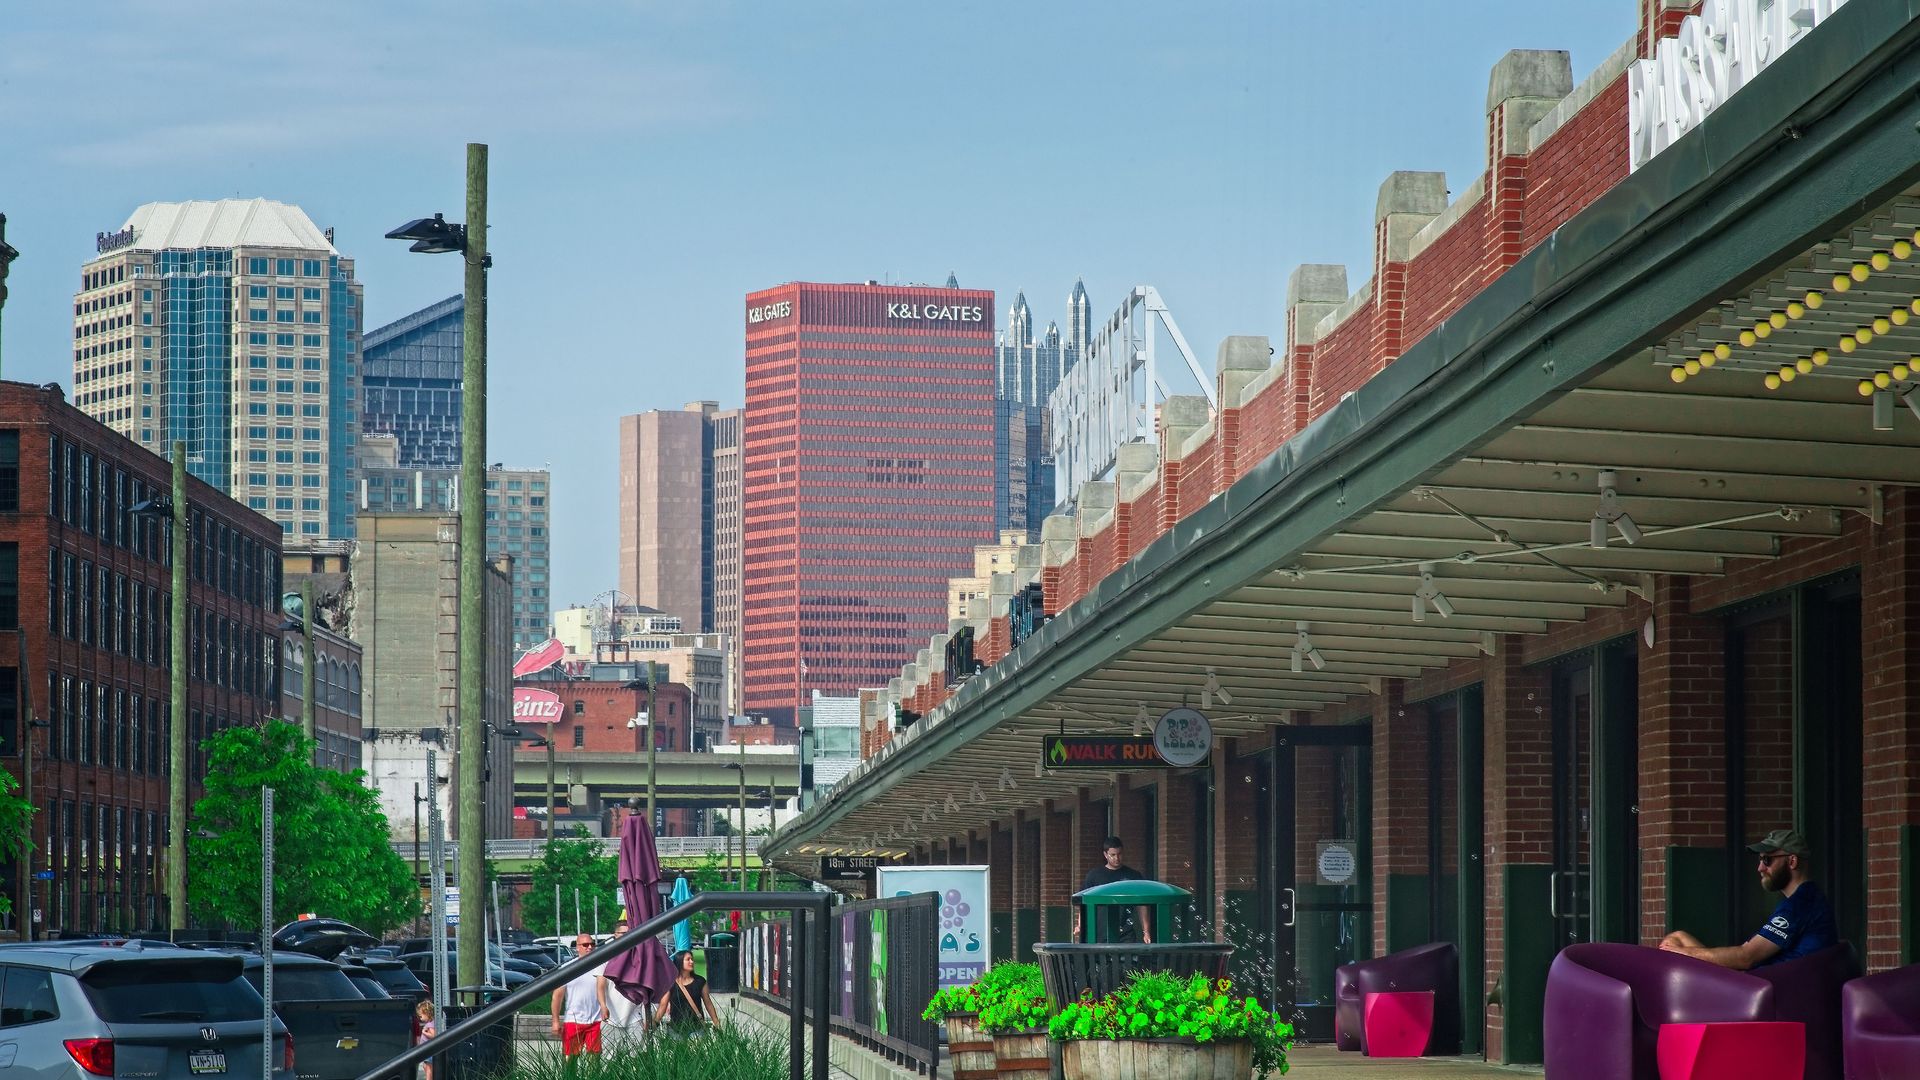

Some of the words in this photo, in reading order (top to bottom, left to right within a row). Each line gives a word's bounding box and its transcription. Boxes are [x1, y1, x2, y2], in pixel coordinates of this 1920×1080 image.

[749, 306, 764, 323] K&L
[764, 301, 791, 320] GATES
[887, 303, 921, 319] K&L
[924, 304, 982, 322] GATES
[514, 696, 558, 717] einz
[1066, 744, 1116, 760] WALK
[829, 858, 845, 868] 18TH
[849, 857, 877, 868] STREET
[939, 967, 978, 980] OPEN
